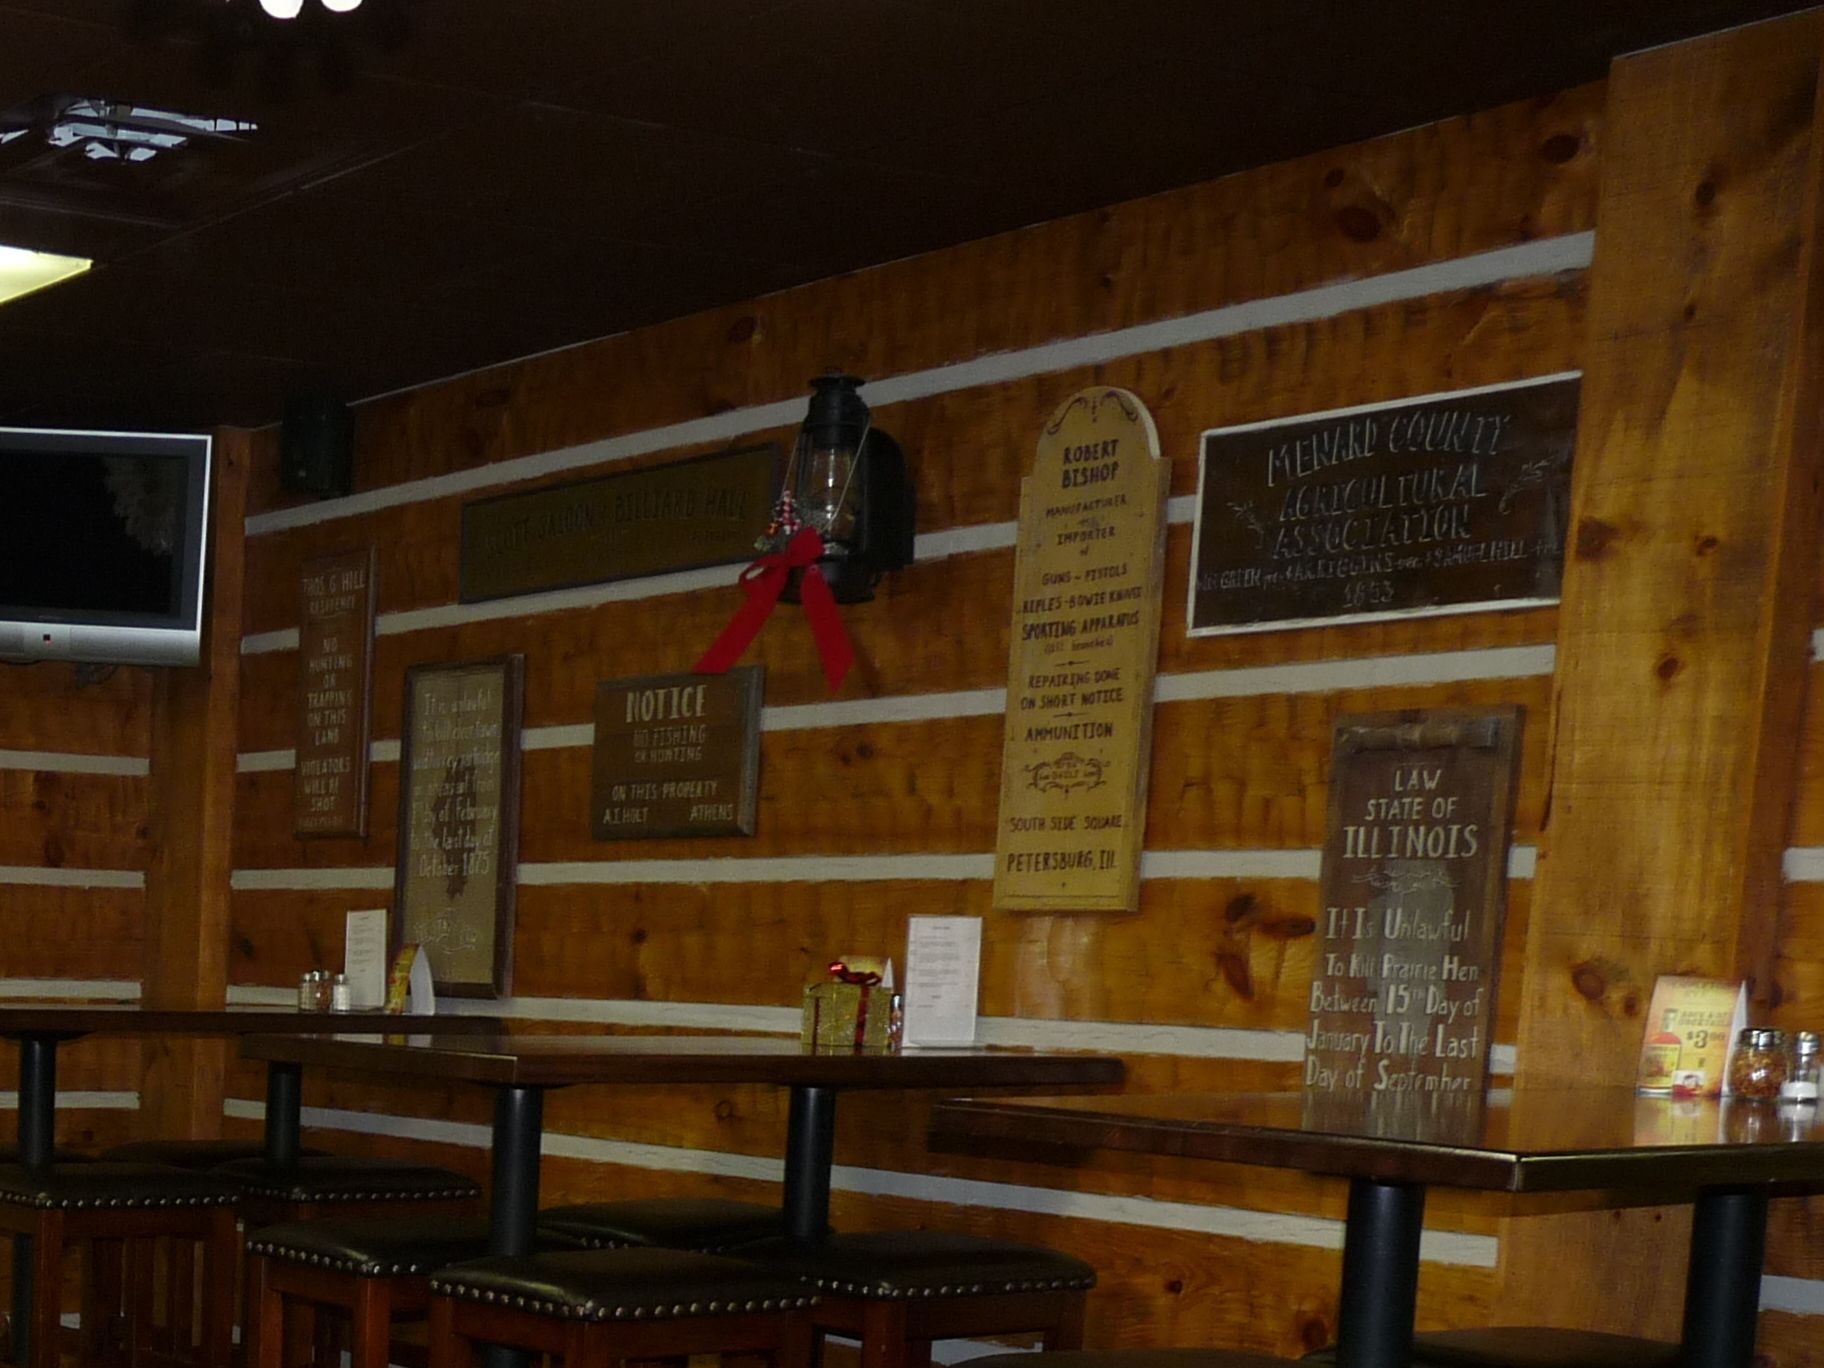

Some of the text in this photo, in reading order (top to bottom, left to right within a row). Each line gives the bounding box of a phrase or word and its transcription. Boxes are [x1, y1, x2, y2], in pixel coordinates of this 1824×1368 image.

[1063, 439, 1120, 465] ROBERT
[1268, 411, 1512, 488] MENARD COUNTY
[1061, 461, 1121, 490] BISHOP
[1279, 463, 1488, 522] AGRICULTURAL
[613, 487, 696, 523] BILLIARD
[1045, 493, 1128, 519] MANUFACTURER
[1057, 525, 1116, 547] IMPORTER
[1271, 504, 1473, 560] ASSOCIATION
[341, 569, 366, 592] HILL
[1042, 563, 1128, 587] GUNS PISTOLS
[1021, 610, 1141, 642] SPORTING APPARATUS
[322, 637, 337, 654] NO
[309, 655, 353, 673] HUNTING
[1027, 667, 1121, 689] REPAIRING DONE
[307, 689, 353, 709] TRAPPING
[625, 684, 708, 724] NOTICE
[1019, 687, 1125, 712] ON SHORT NOTICE
[323, 708, 346, 725] THIS
[652, 724, 707, 747] FISHING
[1024, 721, 1114, 743] AMMUNITION
[300, 756, 351, 777] VIOLATORS
[650, 746, 703, 763] HUNTING
[612, 780, 718, 802] ON THIS PROPERTY
[1394, 769, 1442, 792] LAW
[310, 796, 336, 813] SHOT
[689, 803, 735, 822] ATHENS
[1364, 797, 1460, 821] STATE OF
[1009, 814, 1123, 833] SOUTH SIDE SQUARE
[1342, 824, 1479, 860] ILLINOIS
[462, 850, 491, 877] 1875
[1325, 907, 1471, 942] It Is Unlawful
[1325, 953, 1480, 981] To Kill Prairie Hen
[1309, 980, 1378, 1014] Between
[1424, 984, 1459, 1025] Day
[1462, 987, 1485, 1016] of
[1305, 1019, 1480, 1058] January To The Last
[1305, 1055, 1472, 1092] Day of September
